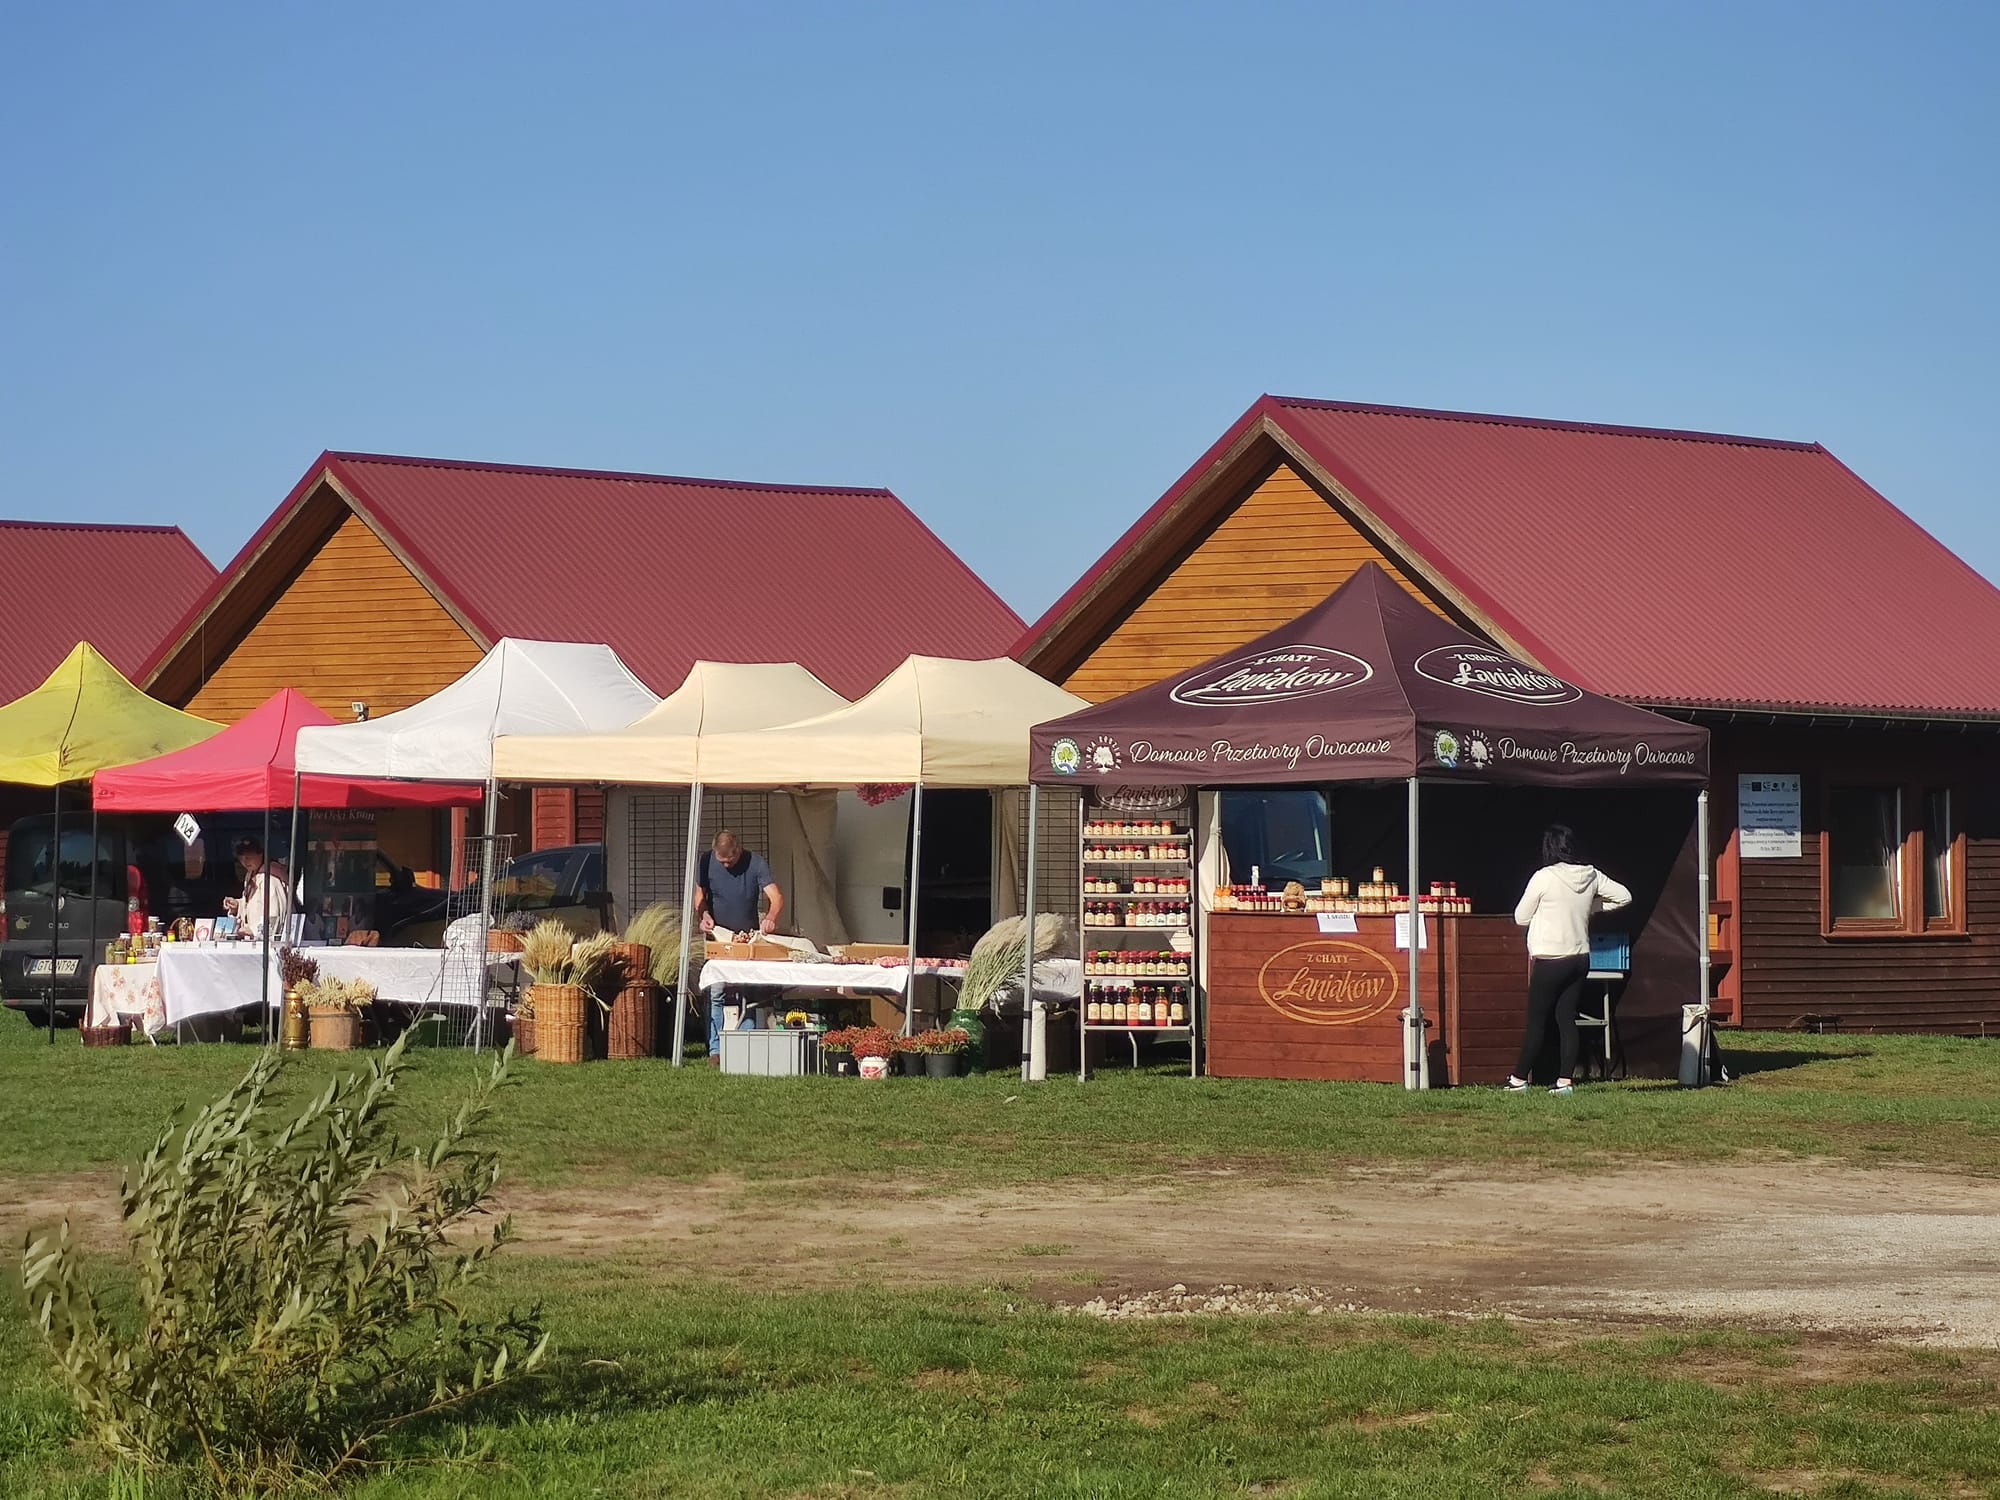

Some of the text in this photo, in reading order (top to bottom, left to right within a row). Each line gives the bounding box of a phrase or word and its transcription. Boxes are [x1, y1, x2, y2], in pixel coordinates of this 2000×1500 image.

[1266, 654, 1318, 664] CHATY
[1129, 734, 1392, 770] Domowe Przetwory Owocowe
[1497, 737, 1696, 775] Domowe Przetwory Owocowe
[1306, 953, 1350, 964] Z CHATY
